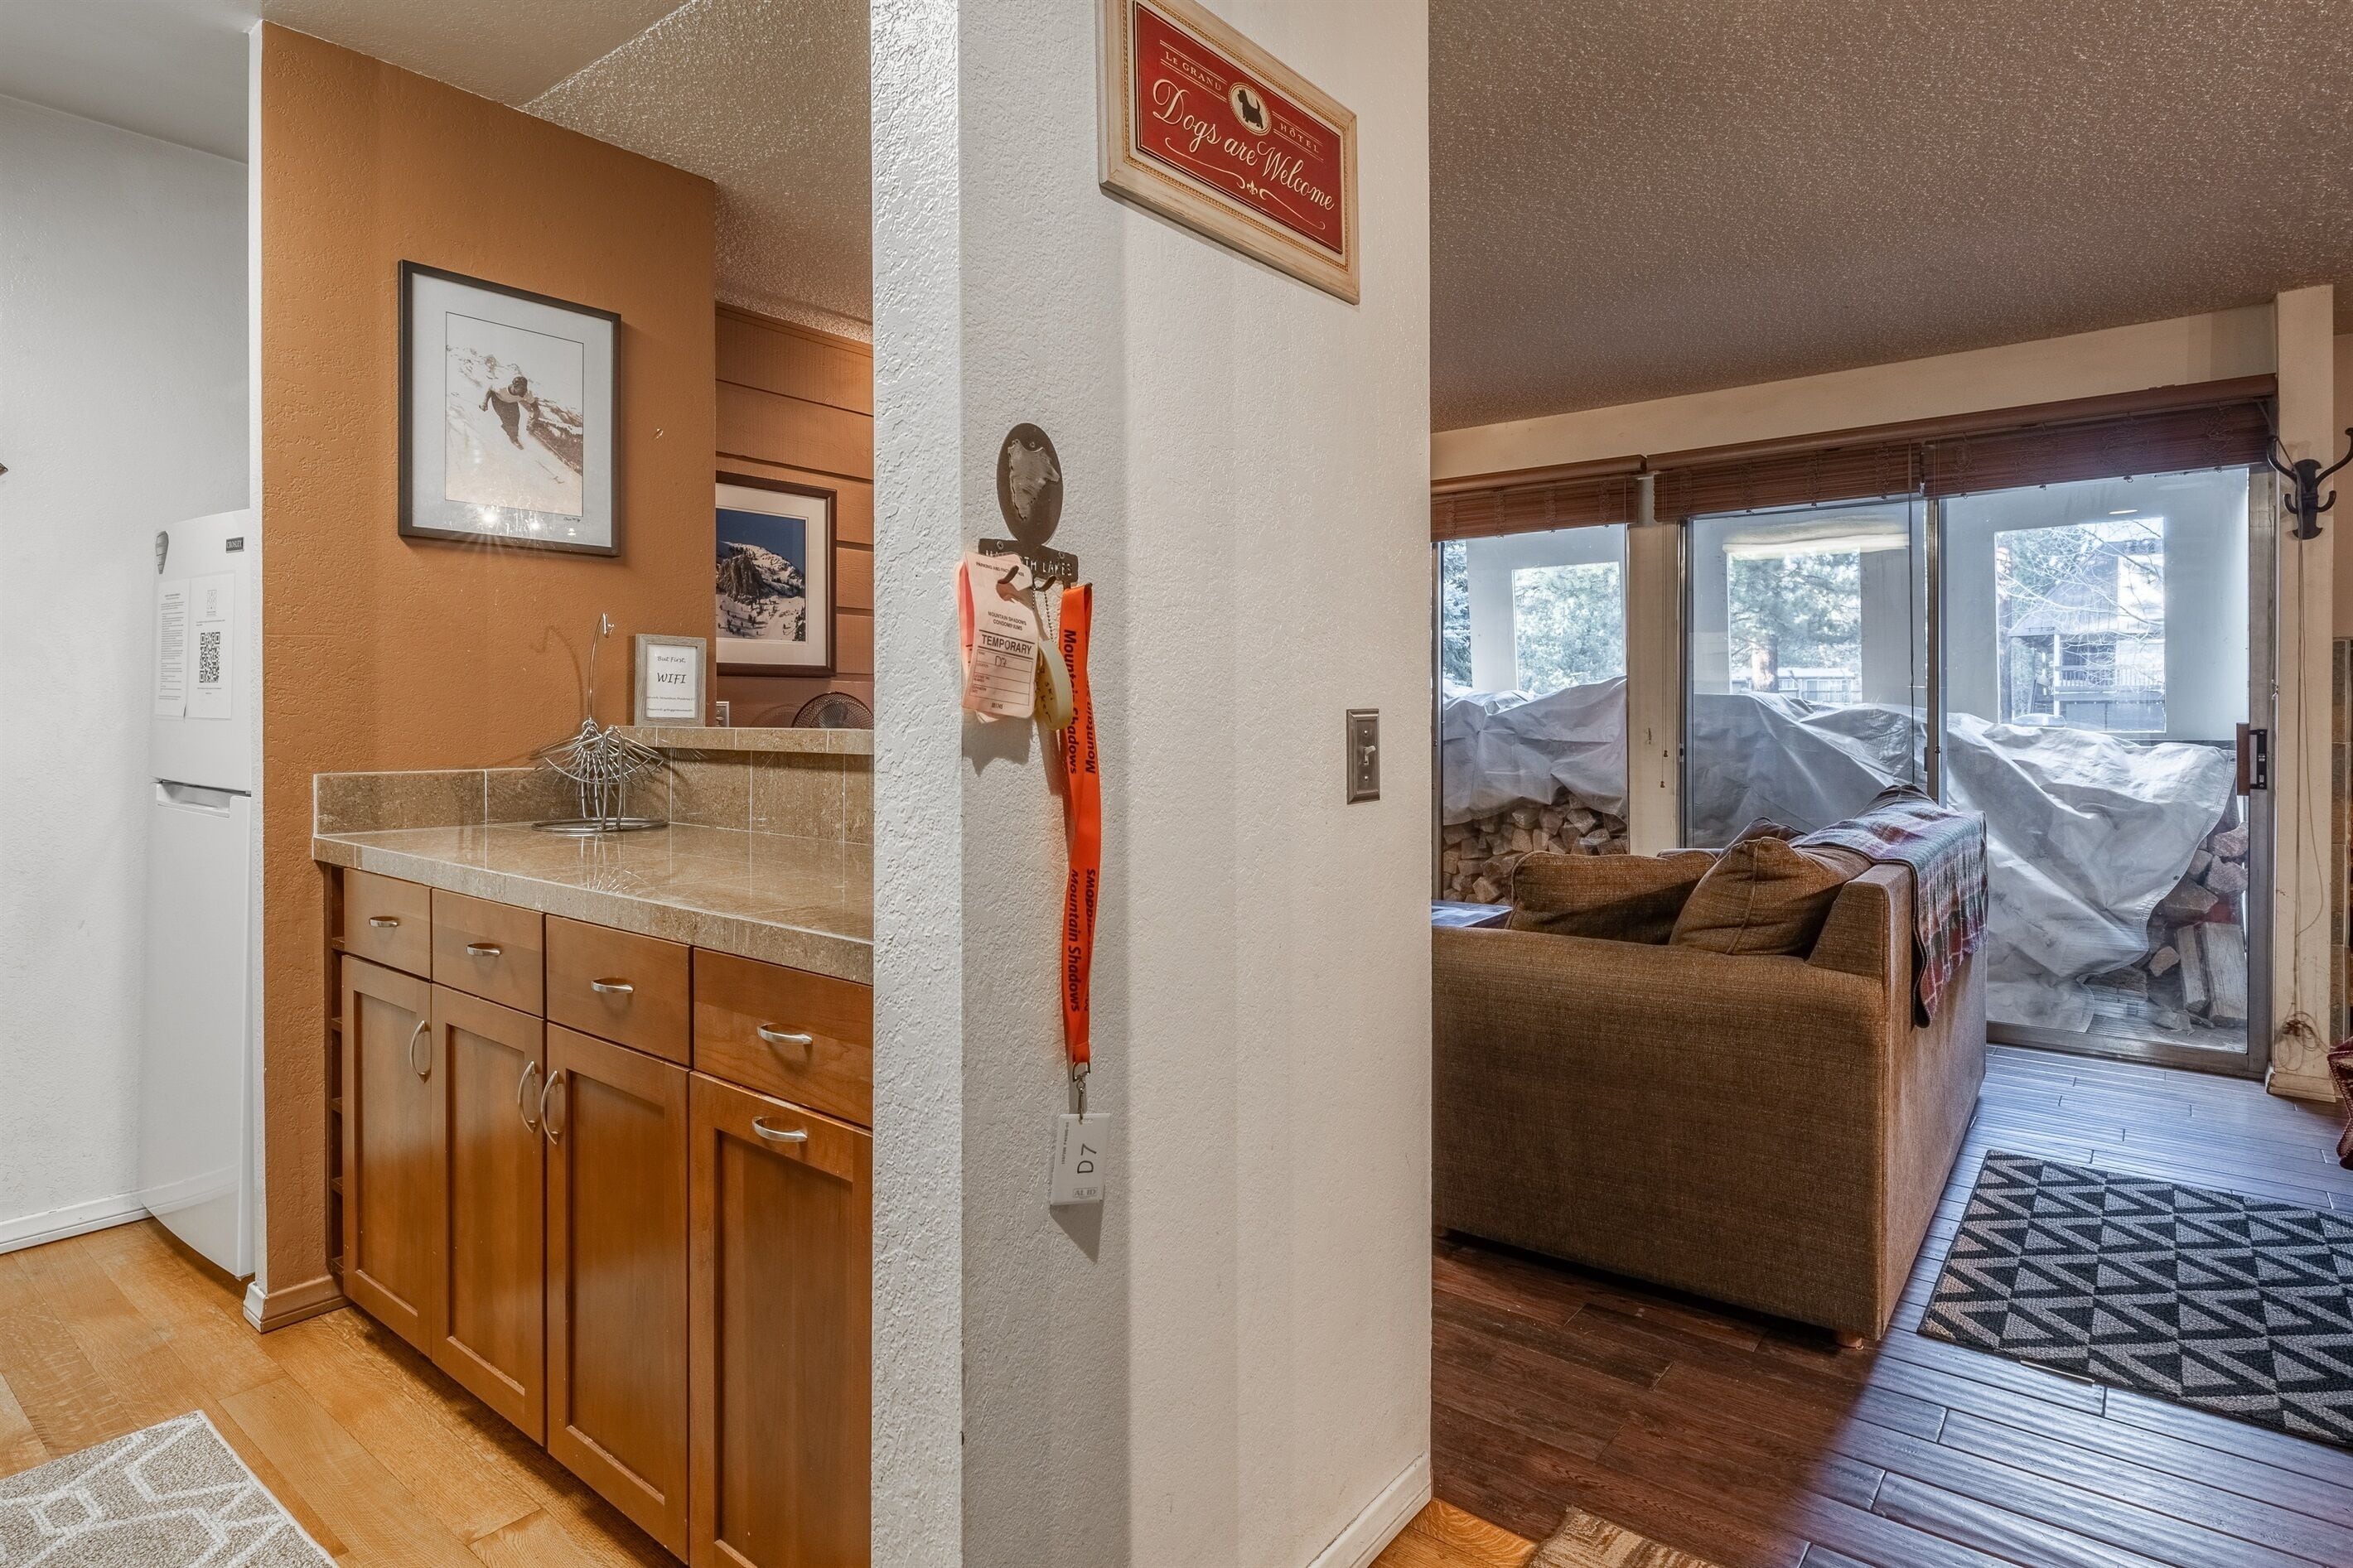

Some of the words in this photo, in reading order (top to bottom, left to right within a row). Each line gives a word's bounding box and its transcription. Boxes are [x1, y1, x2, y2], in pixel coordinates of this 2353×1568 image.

[1182, 62, 1222, 91] GRAND
[1280, 123, 1320, 153] HÔTEL
[1152, 79, 1222, 153] Dogs
[1224, 138, 1259, 166] are
[1257, 141, 1335, 210] Welcome
[1042, 560, 1073, 577] LAKES
[981, 634, 1032, 655] TEMPORARY
[657, 672, 687, 685] WIFI
[1069, 869, 1081, 943] Mountain
[1068, 945, 1082, 1012] Shadows
